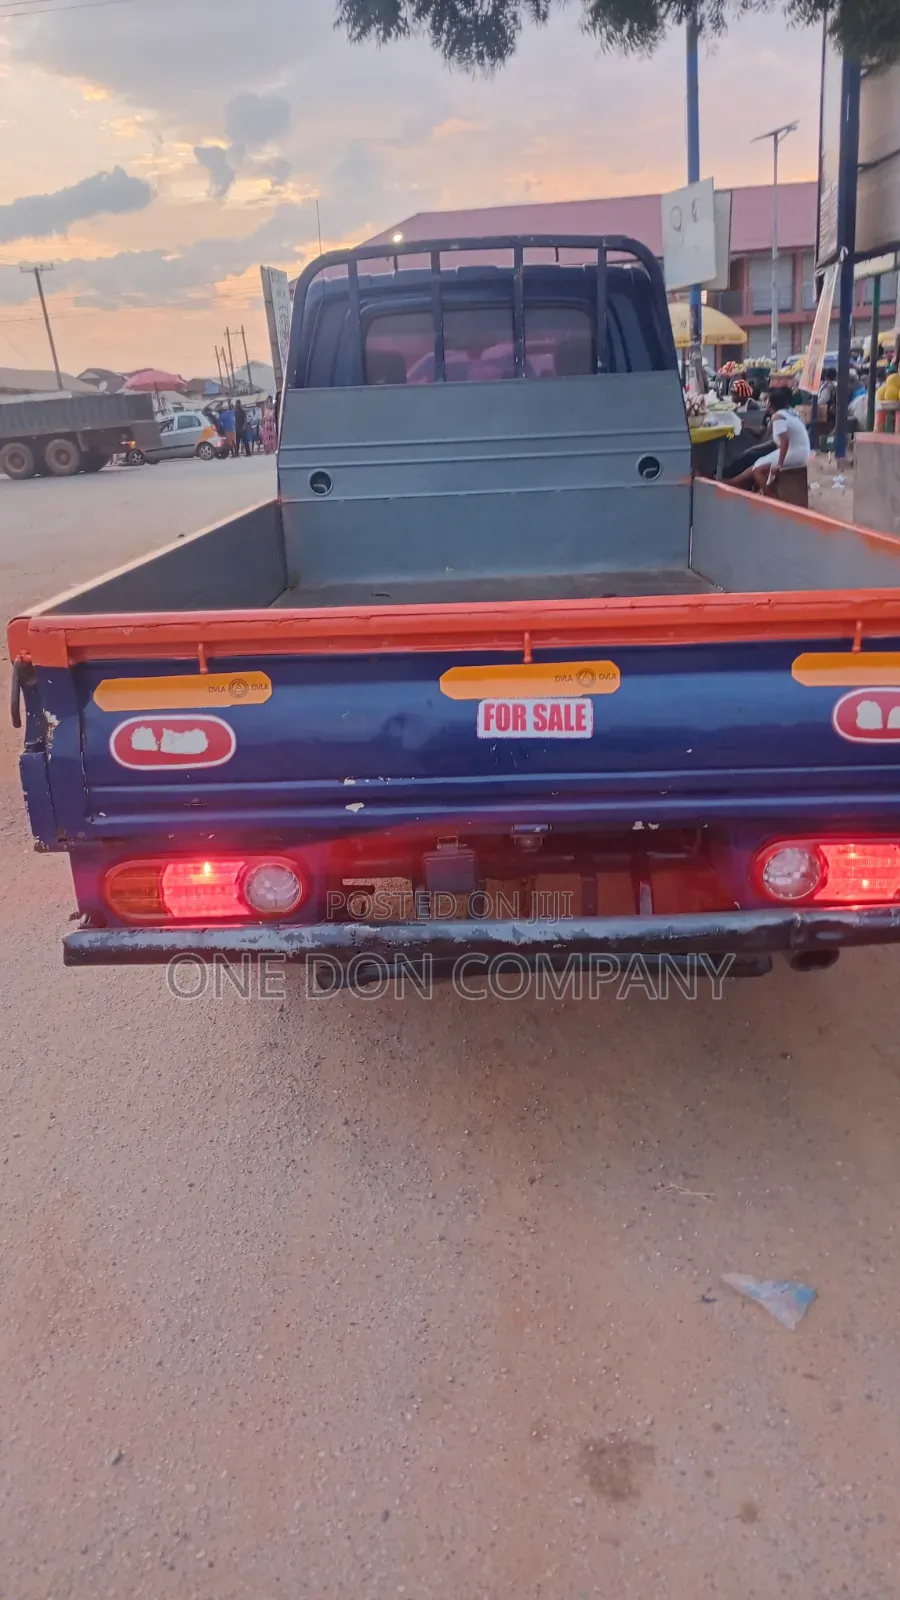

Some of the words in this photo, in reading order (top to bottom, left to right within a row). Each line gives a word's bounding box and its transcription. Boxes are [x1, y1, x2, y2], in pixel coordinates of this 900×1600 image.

[251, 683, 269, 691] DVLA
[483, 703, 527, 732] FOR
[533, 703, 587, 732] SALE
